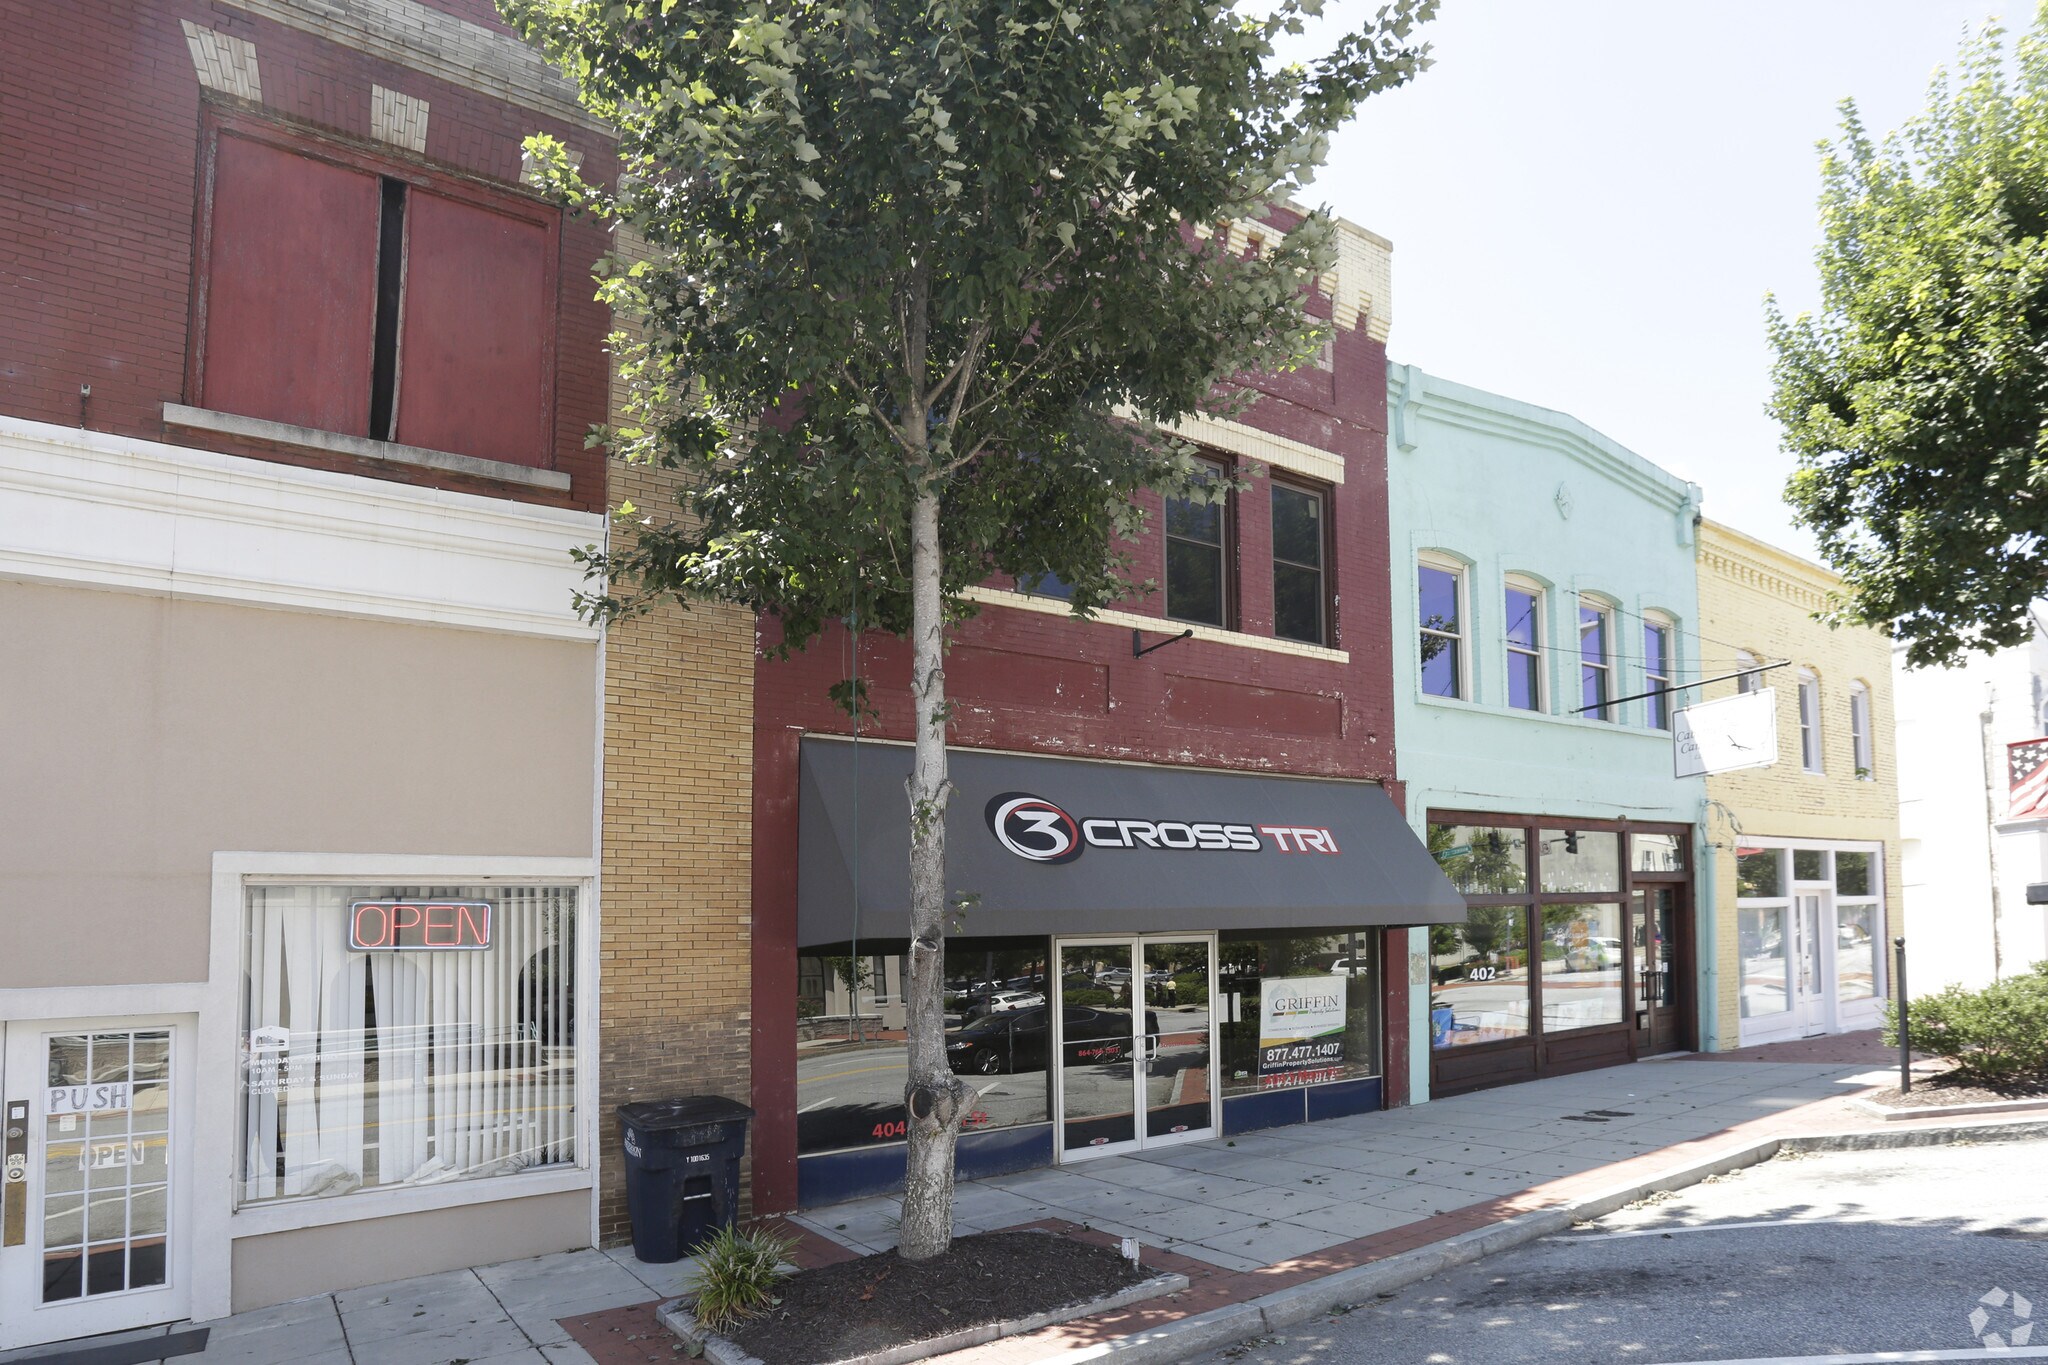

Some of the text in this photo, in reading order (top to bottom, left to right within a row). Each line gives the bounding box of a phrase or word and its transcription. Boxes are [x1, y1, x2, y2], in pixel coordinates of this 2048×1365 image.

[1082, 818, 1261, 850] CROSS
[1259, 825, 1340, 853] TRI
[355, 906, 488, 946] OPEN
[1469, 966, 1496, 981] 402
[1275, 995, 1338, 1011] GRIFFIN
[1266, 1042, 1340, 1062] 877.477.1407
[251, 1057, 294, 1067] MONDAY
[251, 1067, 276, 1075] 10AM
[284, 1064, 303, 1072] 5PM
[251, 1076, 306, 1087] SATURDAY
[319, 1072, 360, 1081] SUNDAY
[50, 1083, 128, 1113] PUSH
[251, 1086, 290, 1096] CLOSED
[871, 1121, 906, 1138] 404
[81, 1142, 142, 1167] OPEN
